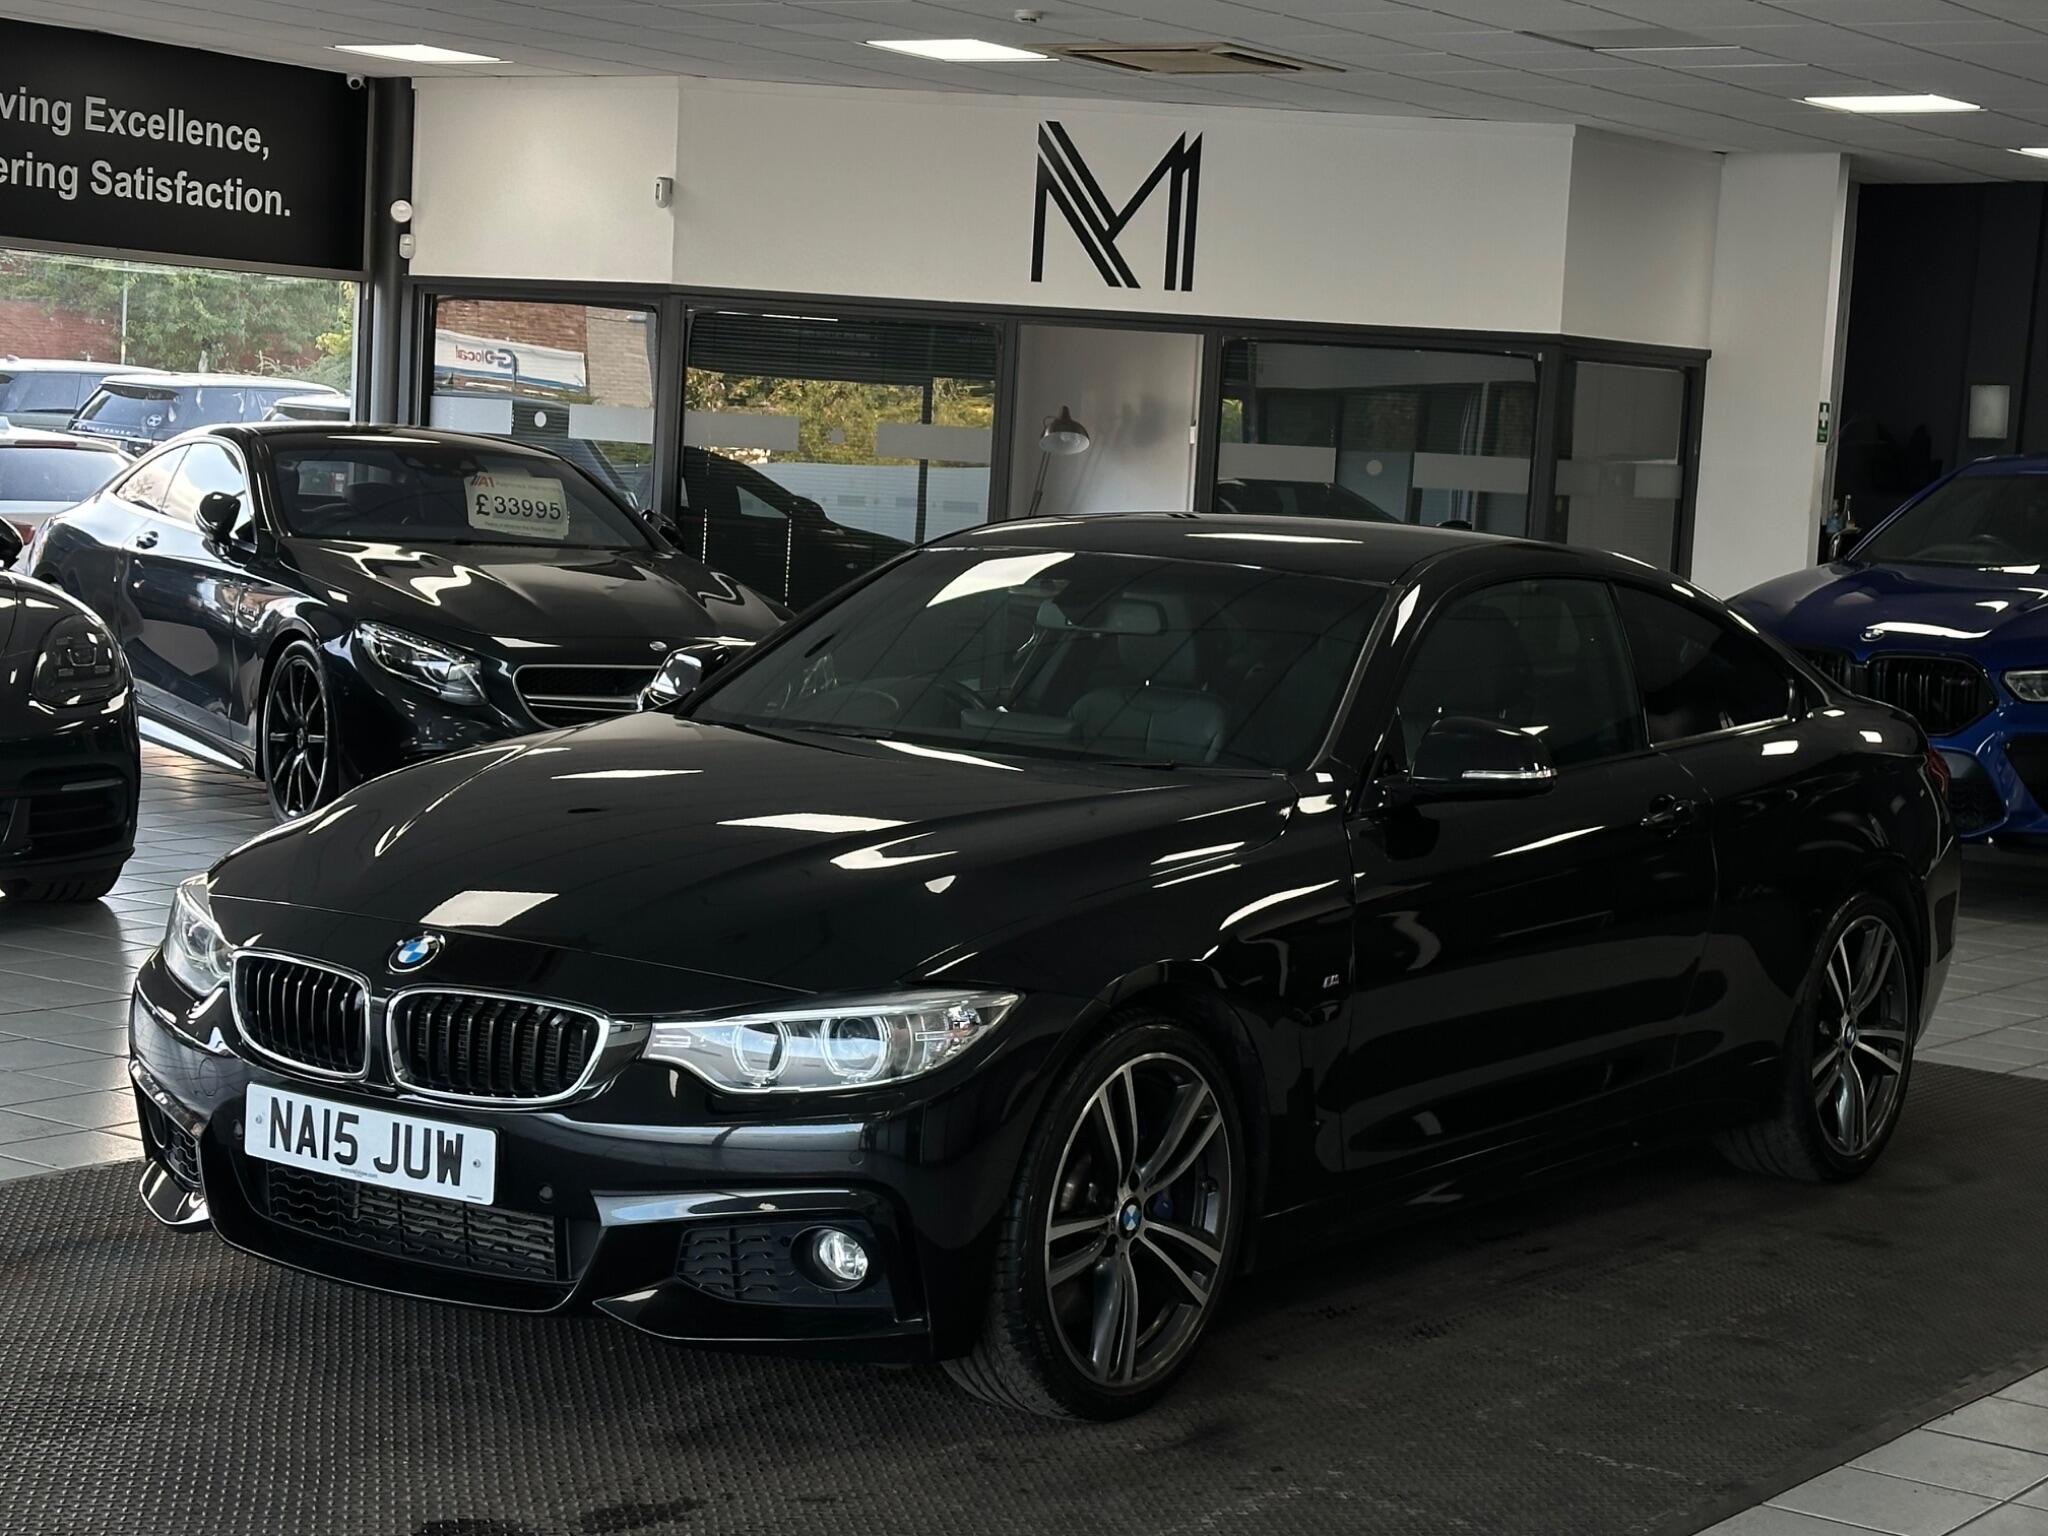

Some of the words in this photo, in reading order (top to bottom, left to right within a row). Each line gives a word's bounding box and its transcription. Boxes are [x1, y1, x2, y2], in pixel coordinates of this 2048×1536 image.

[84, 95, 269, 160] Excellence,
[90, 160, 291, 217] Satisfaction.
[475, 494, 561, 520] £33995
[269, 1096, 360, 1166] NA15
[373, 1122, 464, 1187] JUW
